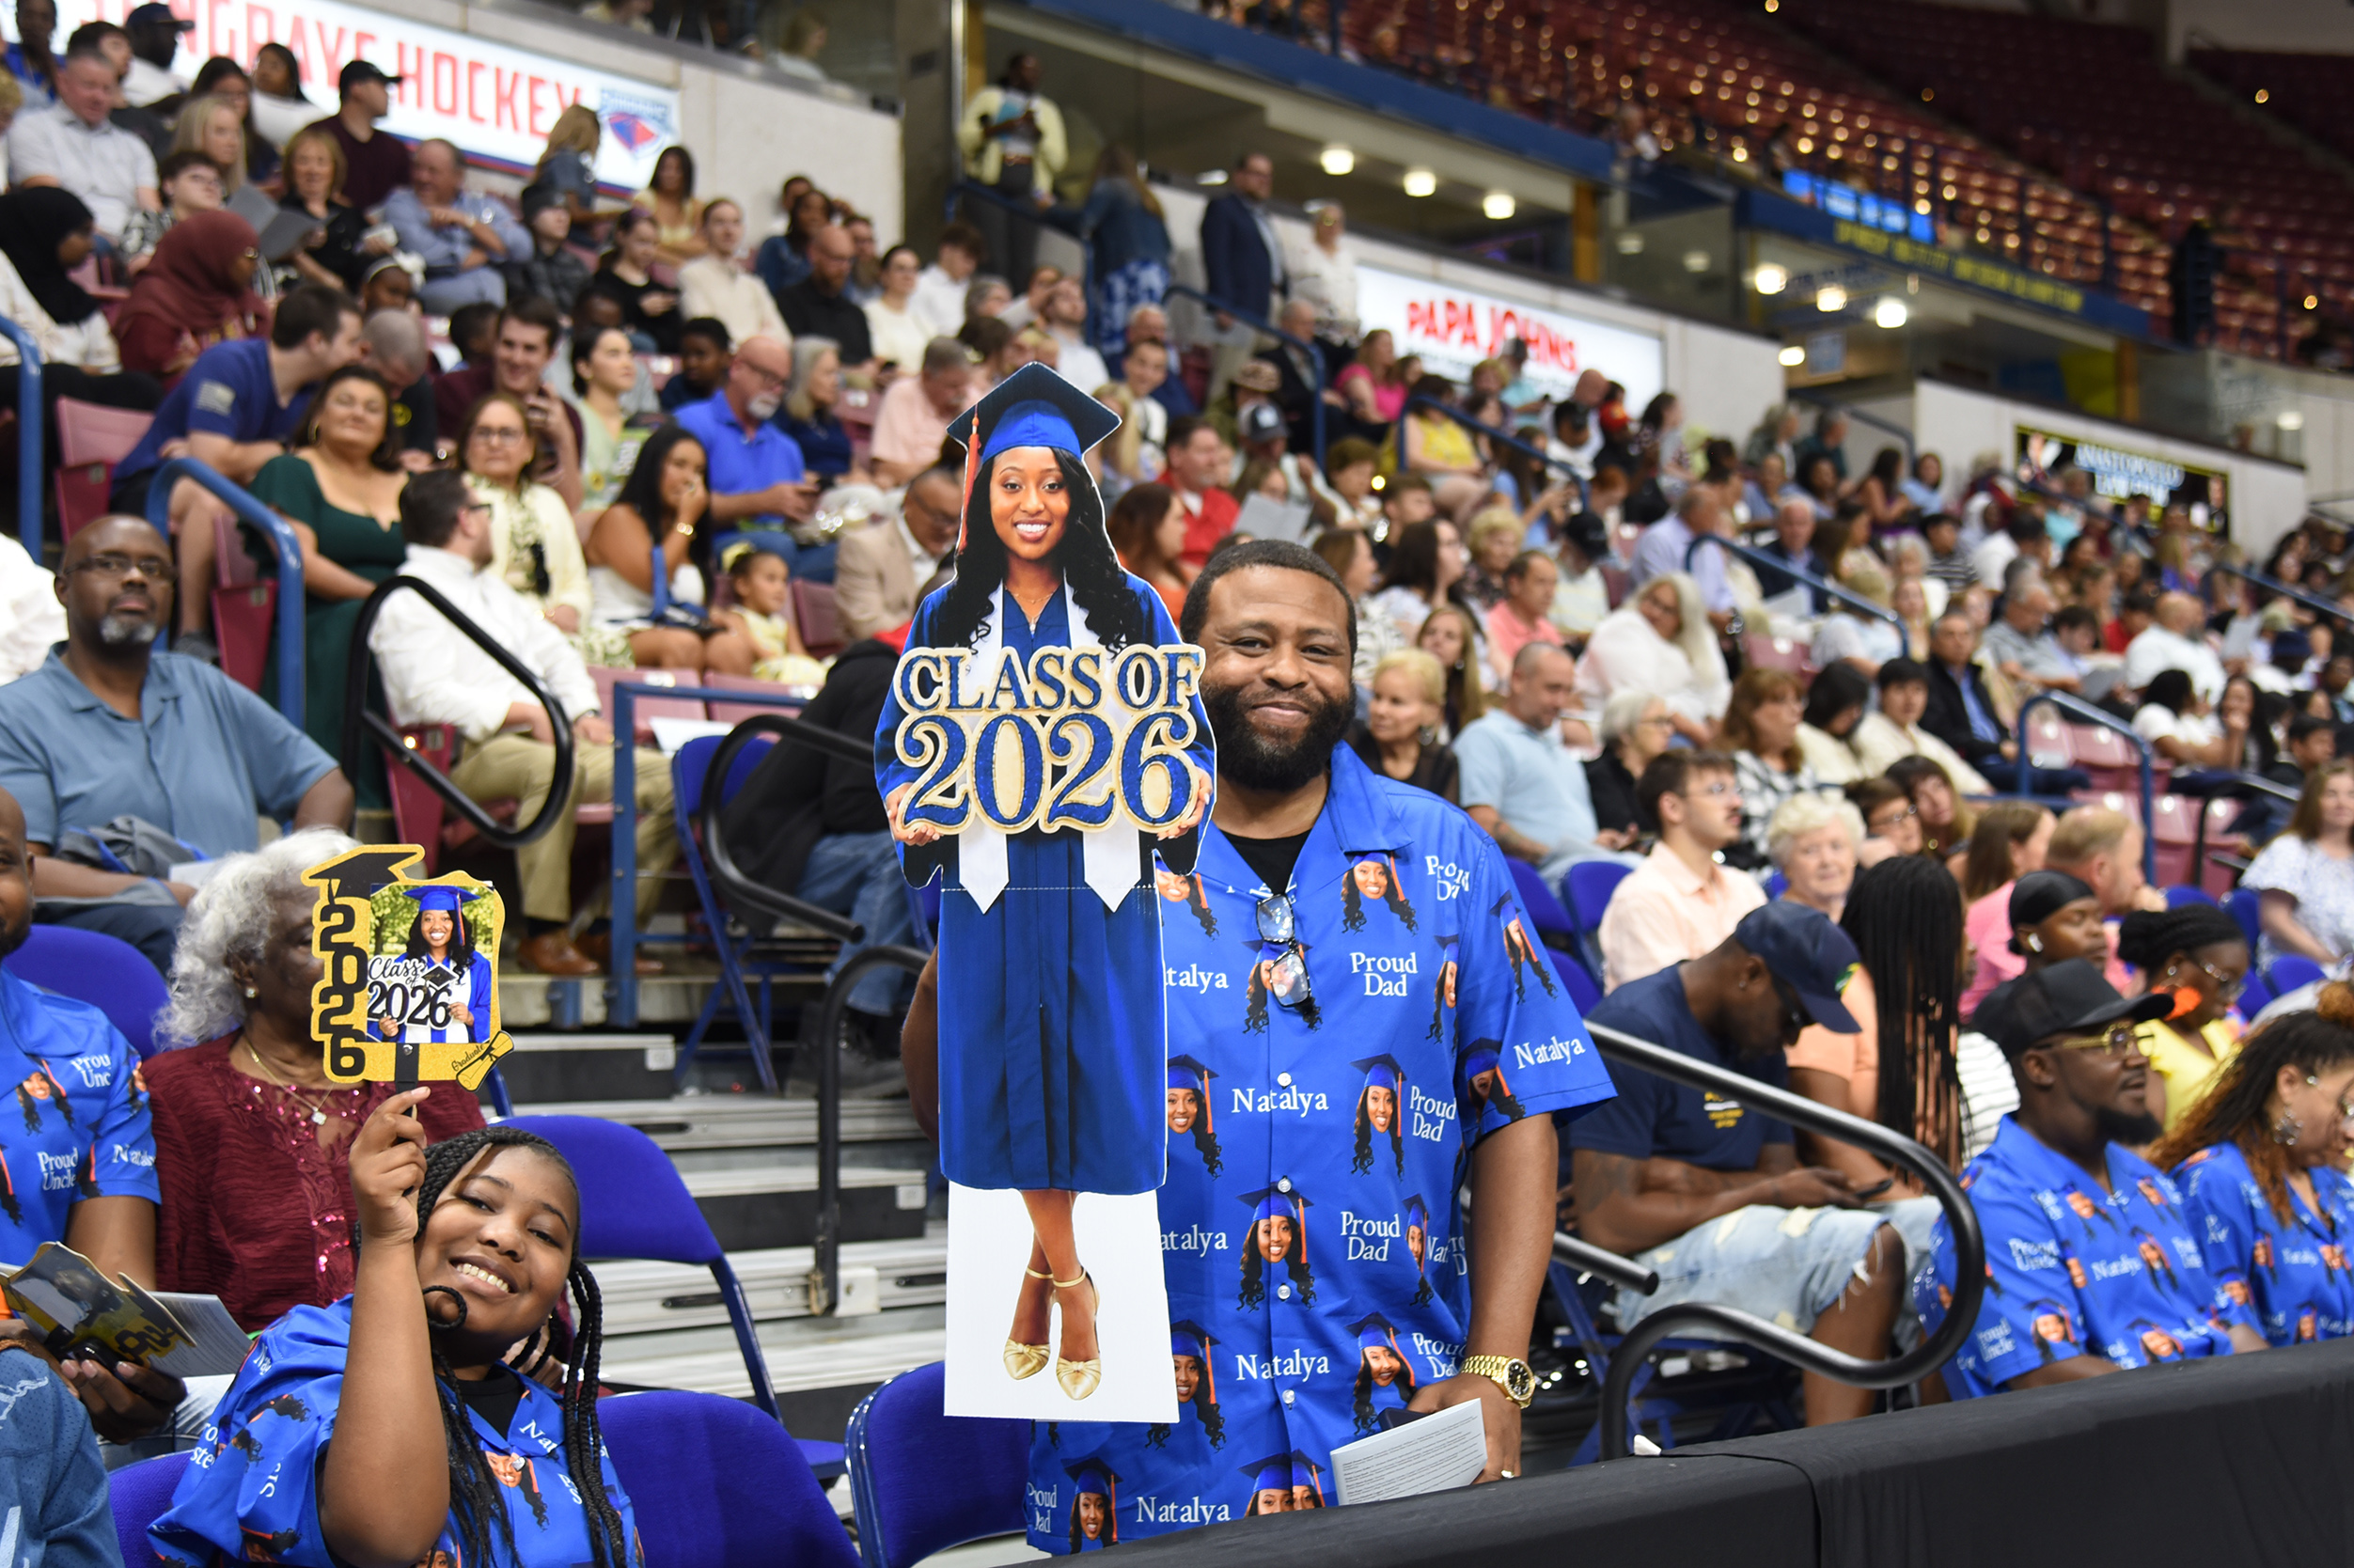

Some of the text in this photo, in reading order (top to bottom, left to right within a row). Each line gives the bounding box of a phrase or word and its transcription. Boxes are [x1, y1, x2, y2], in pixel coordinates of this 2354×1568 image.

[1407, 300, 1480, 350] PAPA
[899, 651, 1201, 711] CLASS OF
[902, 712, 1193, 827] 2026
[369, 957, 426, 980] Class
[1349, 951, 1419, 975] Proud
[318, 902, 369, 1077] 2026
[1166, 963, 1230, 995] talya
[1362, 972, 1408, 997] Dad
[368, 980, 452, 1028] 2026
[71, 1053, 111, 1073] Prou
[450, 1043, 485, 1073] Graduate
[1514, 1035, 1587, 1070] Natalya
[1232, 1084, 1329, 1119] Natalya
[1410, 1086, 1456, 1120] Proud
[1412, 1113, 1445, 1142] Dad
[37, 1146, 79, 1174] Proud
[41, 1168, 76, 1191] Uncle
[1341, 1211, 1401, 1238] Proud
[1347, 1236, 1389, 1262] Dad
[1234, 1349, 1331, 1383] Natalya
[1137, 1496, 1232, 1526] Natalya
